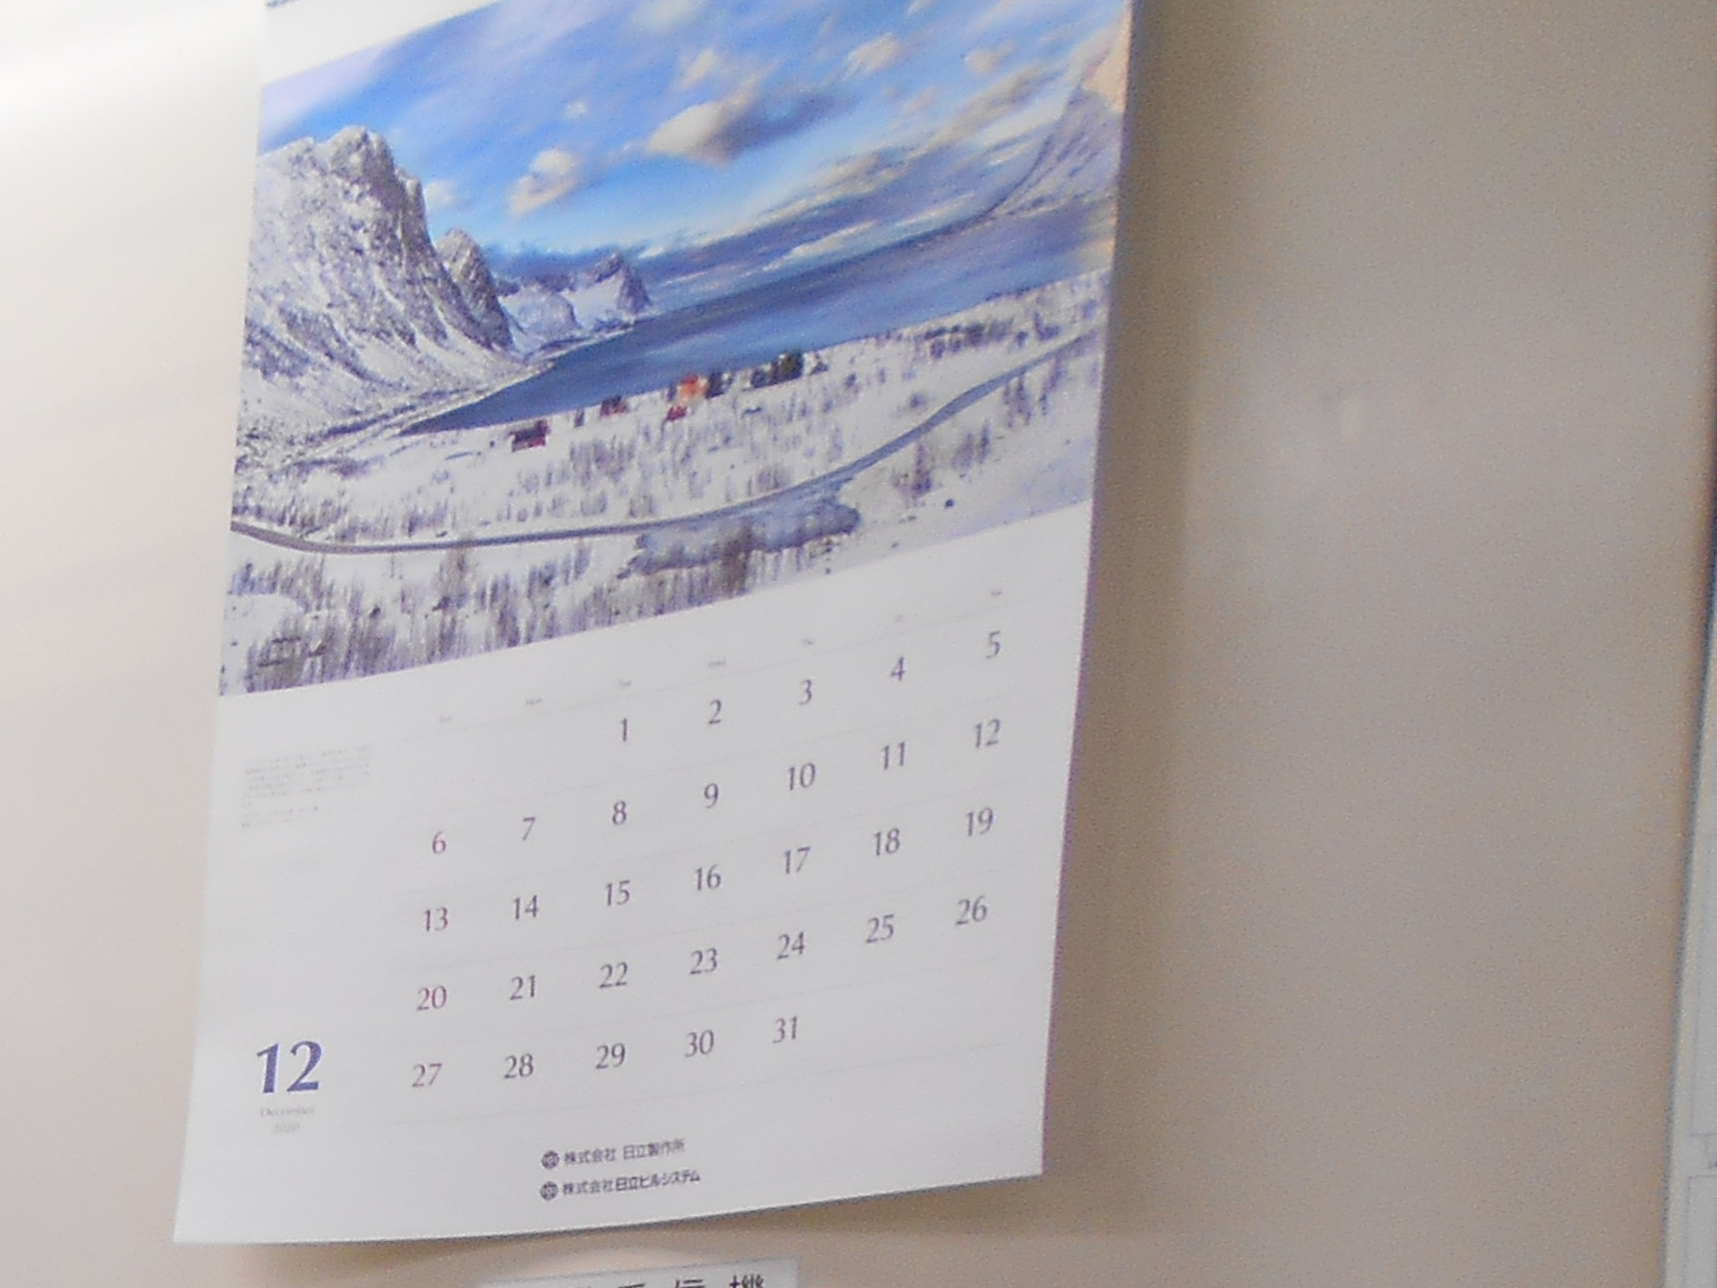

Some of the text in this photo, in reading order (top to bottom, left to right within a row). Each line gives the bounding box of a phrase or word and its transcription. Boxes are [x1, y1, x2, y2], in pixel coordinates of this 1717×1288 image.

[620, 630, 1001, 743] 1 2 3 4 5
[431, 718, 1001, 855] 6 7 8 9 10 11 12
[424, 807, 994, 933] 13 14 15 16 17 18 19
[416, 895, 988, 1012] 20 21 22 23 24 25 26
[256, 1040, 322, 1094] 12
[411, 1015, 798, 1088] 27 28 29 30 31
[563, 1138, 686, 1166] 株式会社 日立製作所
